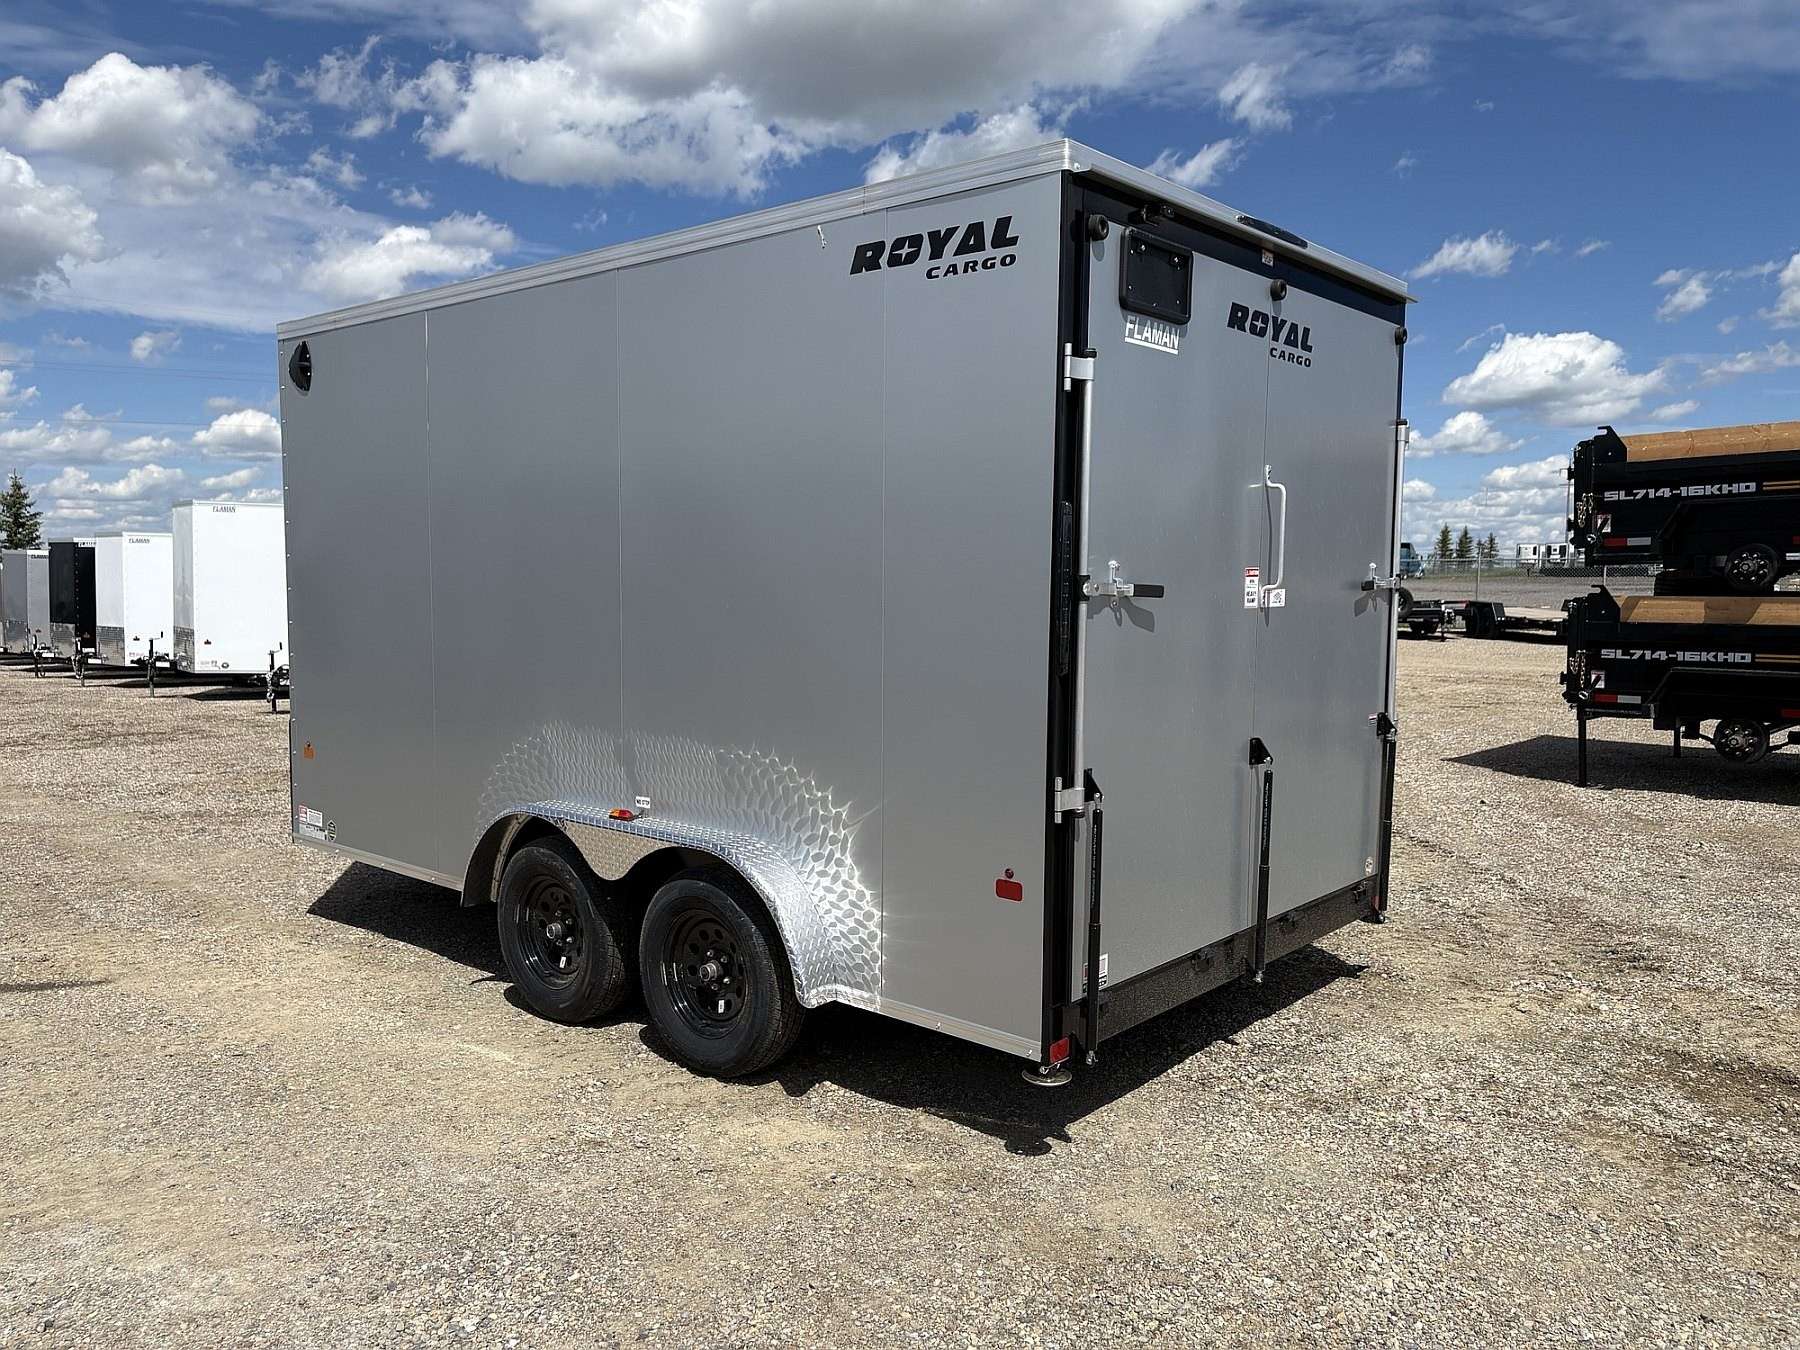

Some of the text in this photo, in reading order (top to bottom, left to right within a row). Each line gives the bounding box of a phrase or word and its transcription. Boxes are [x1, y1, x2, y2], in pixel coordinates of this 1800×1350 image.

[850, 215, 1019, 275] ROYAL
[925, 253, 1017, 280] CARGO
[1125, 315, 1180, 350] FLAMAN
[1227, 301, 1313, 353] ROYAL
[1269, 347, 1312, 368] CARGO
[1603, 482, 1757, 501] SL714-16KHD
[1600, 649, 1752, 663] SL714-16KHD
